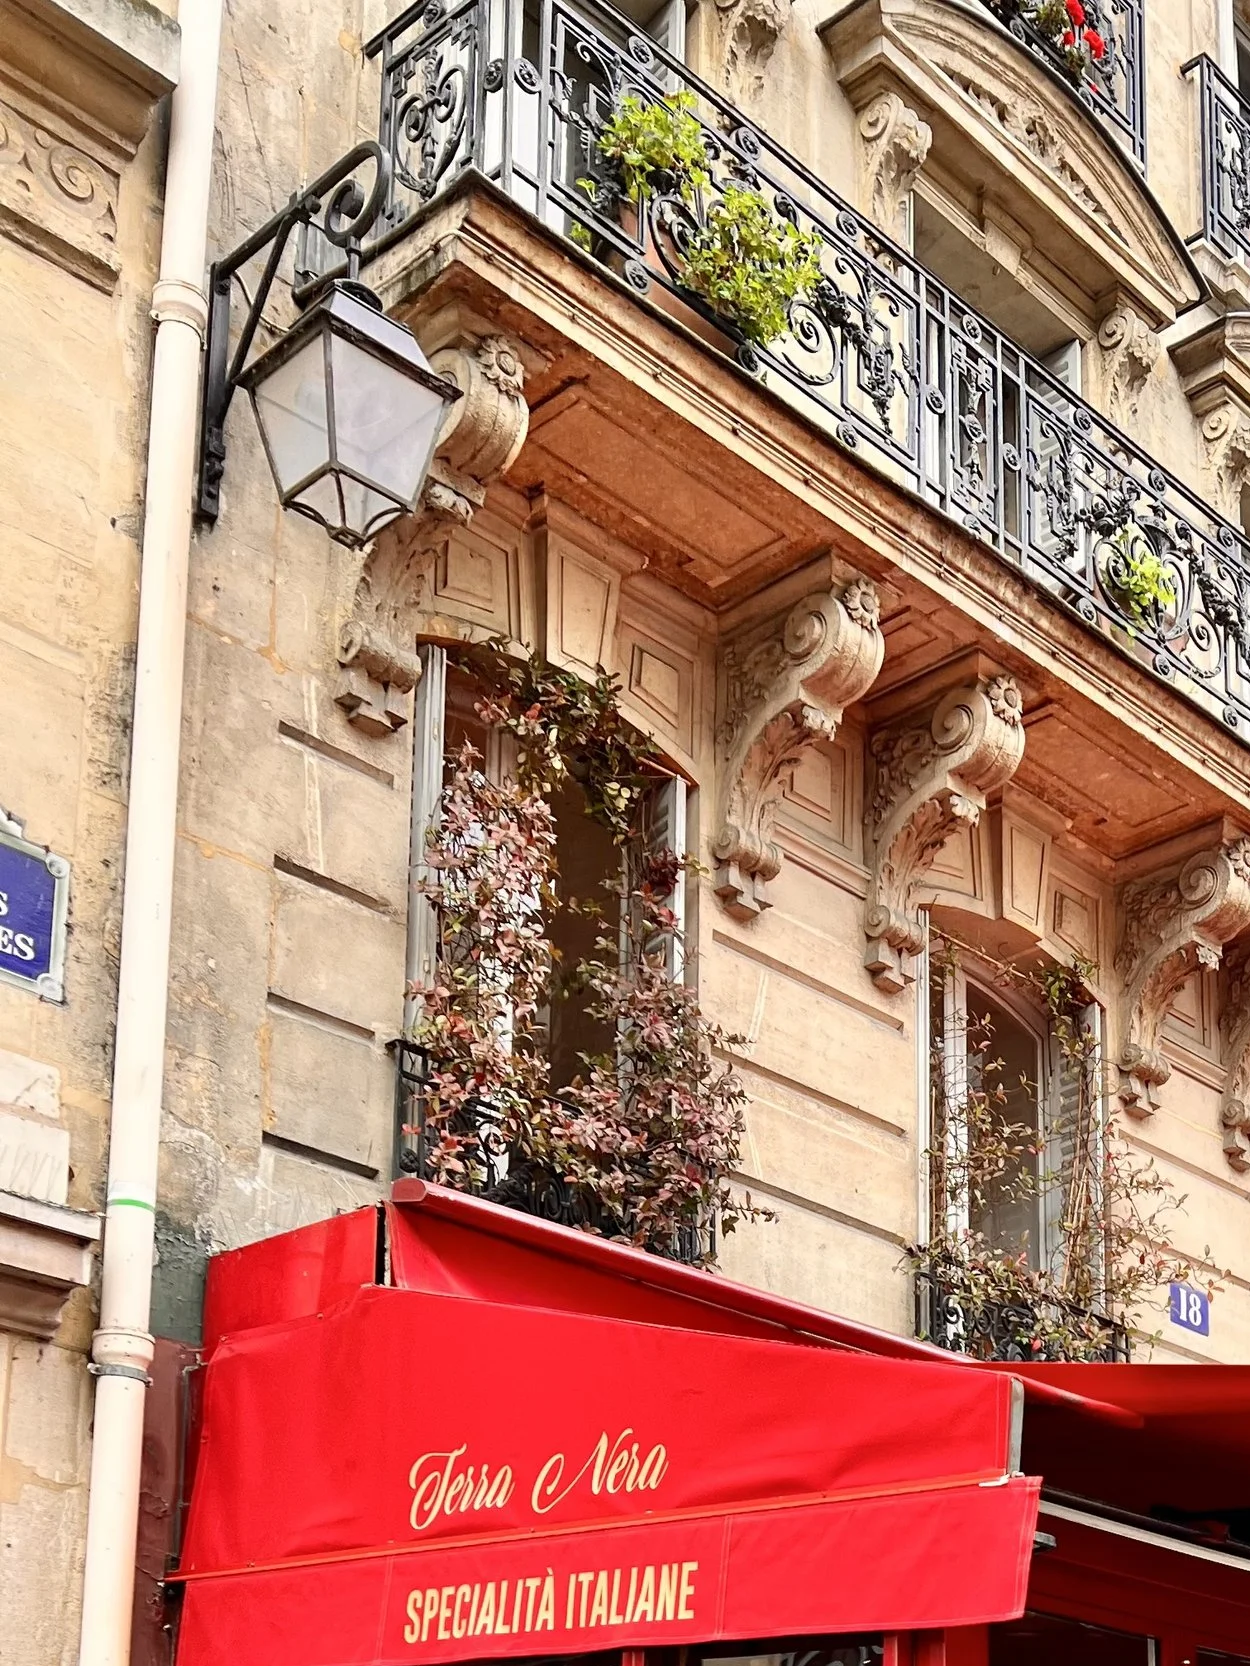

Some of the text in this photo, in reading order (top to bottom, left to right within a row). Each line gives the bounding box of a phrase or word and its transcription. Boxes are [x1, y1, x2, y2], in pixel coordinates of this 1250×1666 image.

[1179, 1287, 1202, 1327] 18
[409, 1427, 669, 1530] Terra Nera
[404, 1560, 699, 1644] SPECIALITÀ ITALIANE
